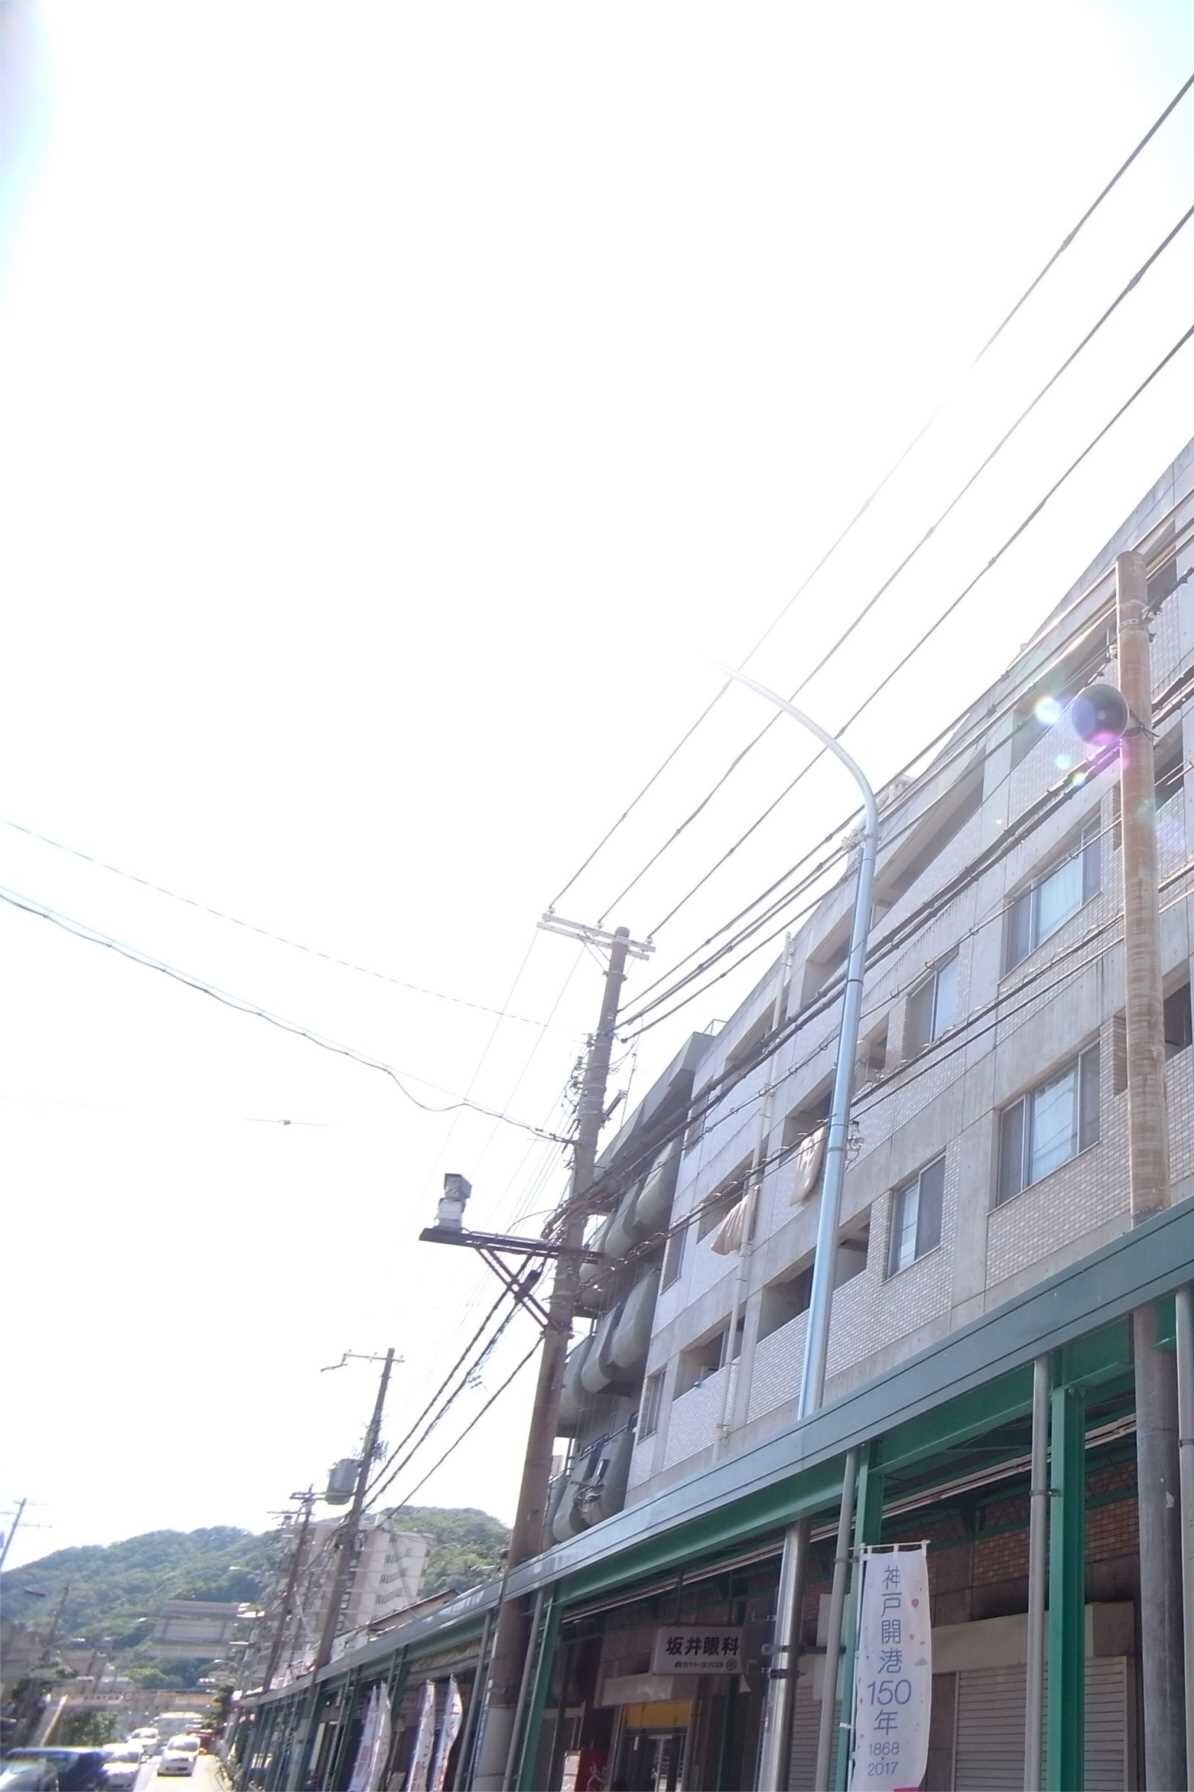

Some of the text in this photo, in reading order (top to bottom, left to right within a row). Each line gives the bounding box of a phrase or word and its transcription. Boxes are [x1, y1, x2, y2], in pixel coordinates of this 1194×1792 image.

[665, 1636, 740, 1656] 坂井眼科
[867, 1761, 898, 1776] 2017
